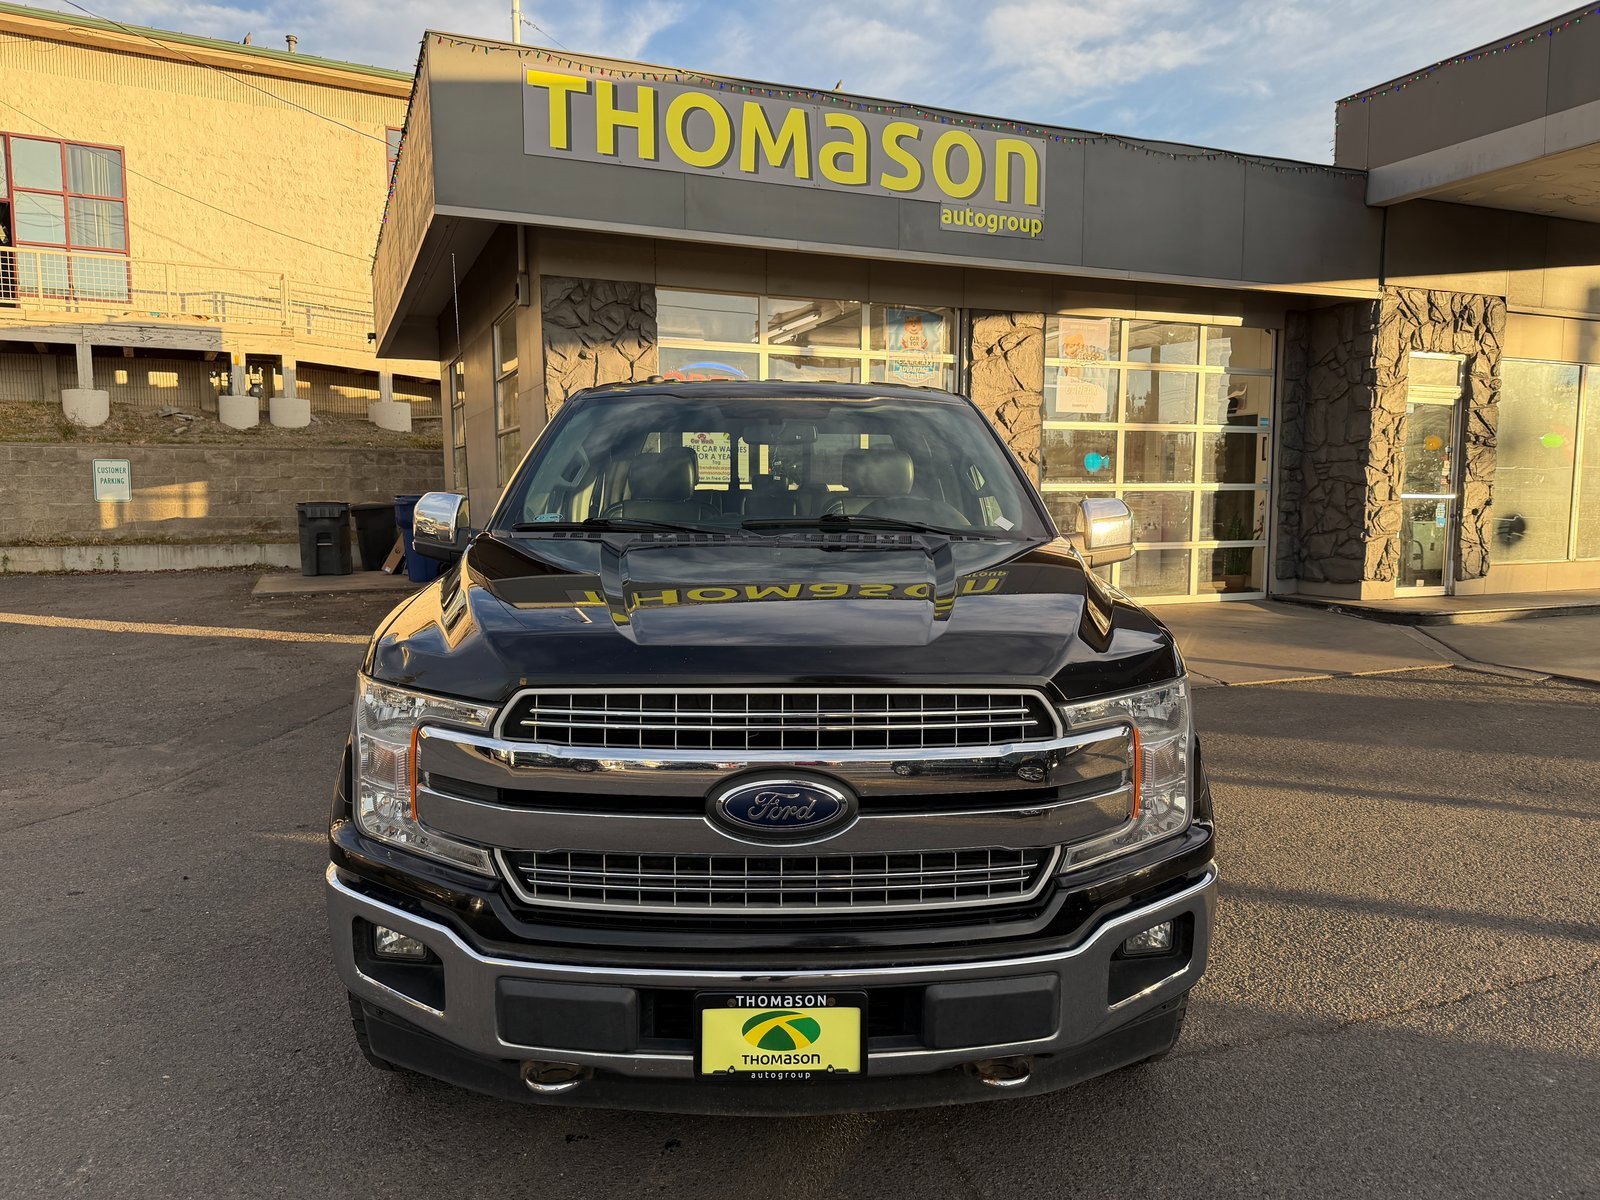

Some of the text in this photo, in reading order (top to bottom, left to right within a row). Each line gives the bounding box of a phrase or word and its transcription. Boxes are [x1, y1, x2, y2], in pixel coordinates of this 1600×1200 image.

[940, 205, 1043, 237] autogroup
[702, 445, 718, 453] CAR
[719, 445, 747, 454] WAES
[97, 466, 127, 474] CUSTOMER
[100, 477, 125, 485] PARKING
[747, 791, 817, 821] Ford
[751, 1071, 811, 1080] autogroup
